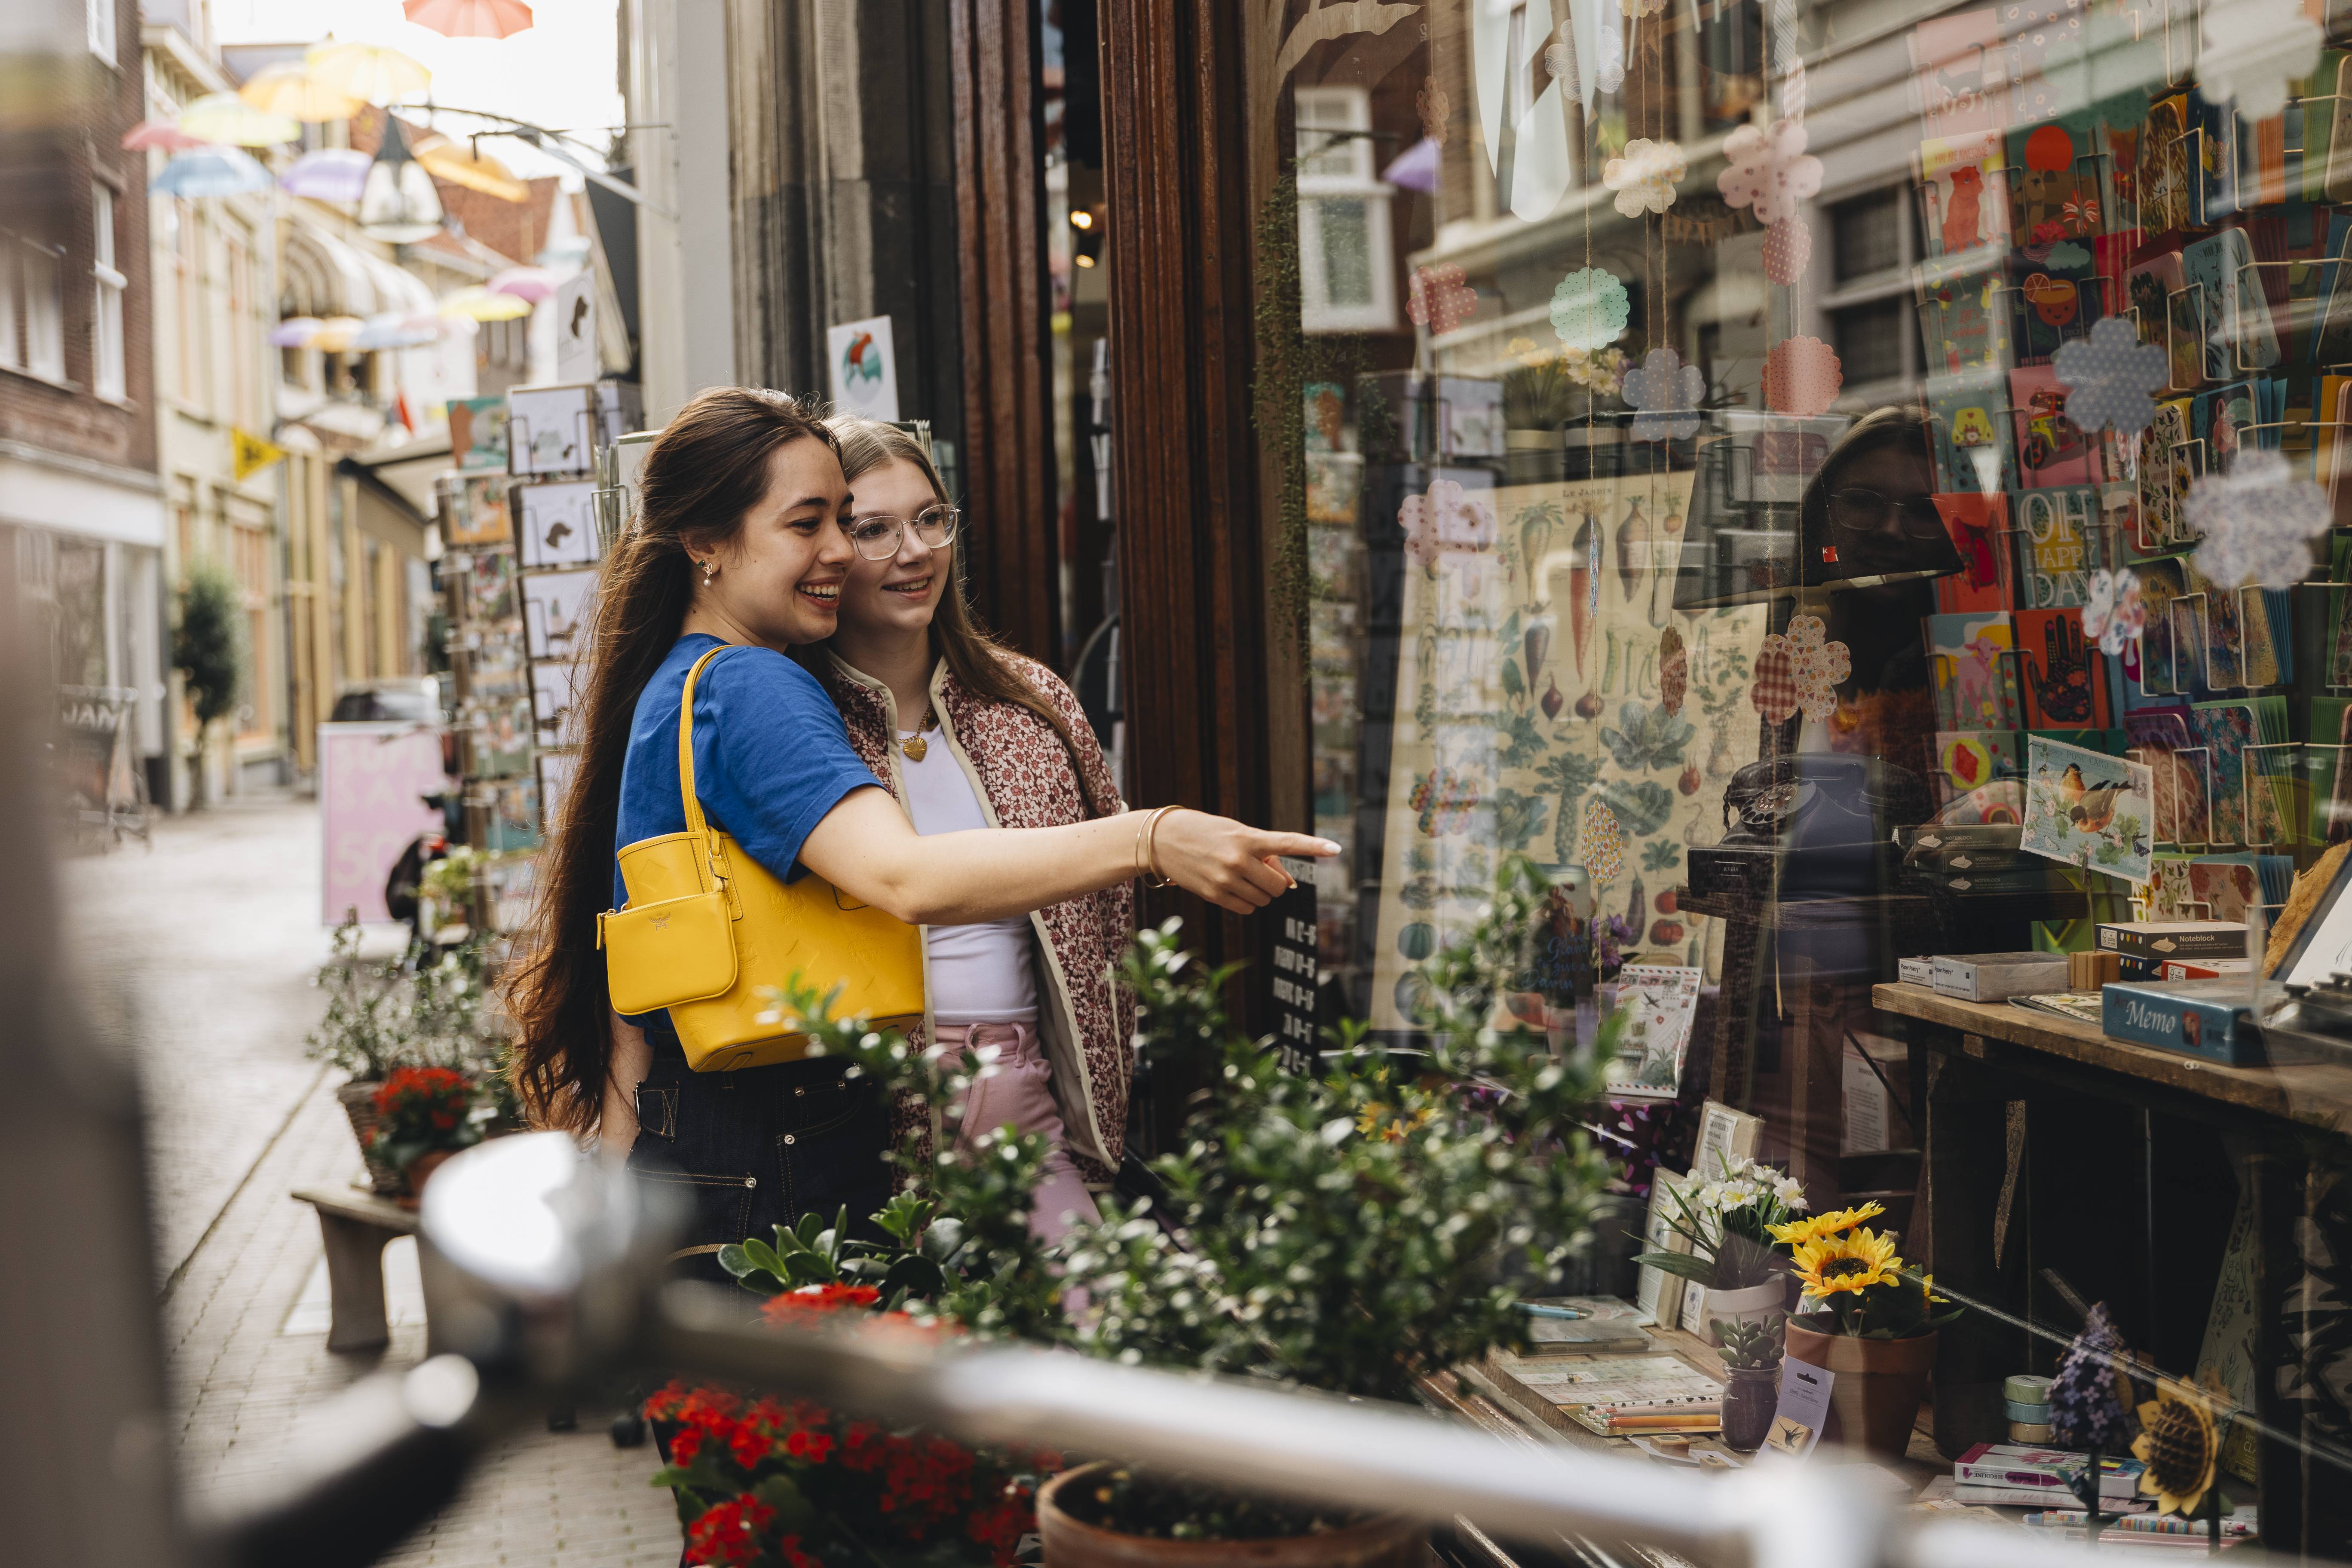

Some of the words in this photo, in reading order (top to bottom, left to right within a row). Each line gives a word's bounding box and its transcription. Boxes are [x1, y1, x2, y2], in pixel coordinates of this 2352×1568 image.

[2019, 490, 2095, 545] OH
[2024, 545, 2096, 570] HAPPY
[2067, 751, 2086, 763] POST
[2089, 757, 2109, 769] CARD
[769, 890, 804, 904] MCM
[2125, 1000, 2176, 1034] Memo
